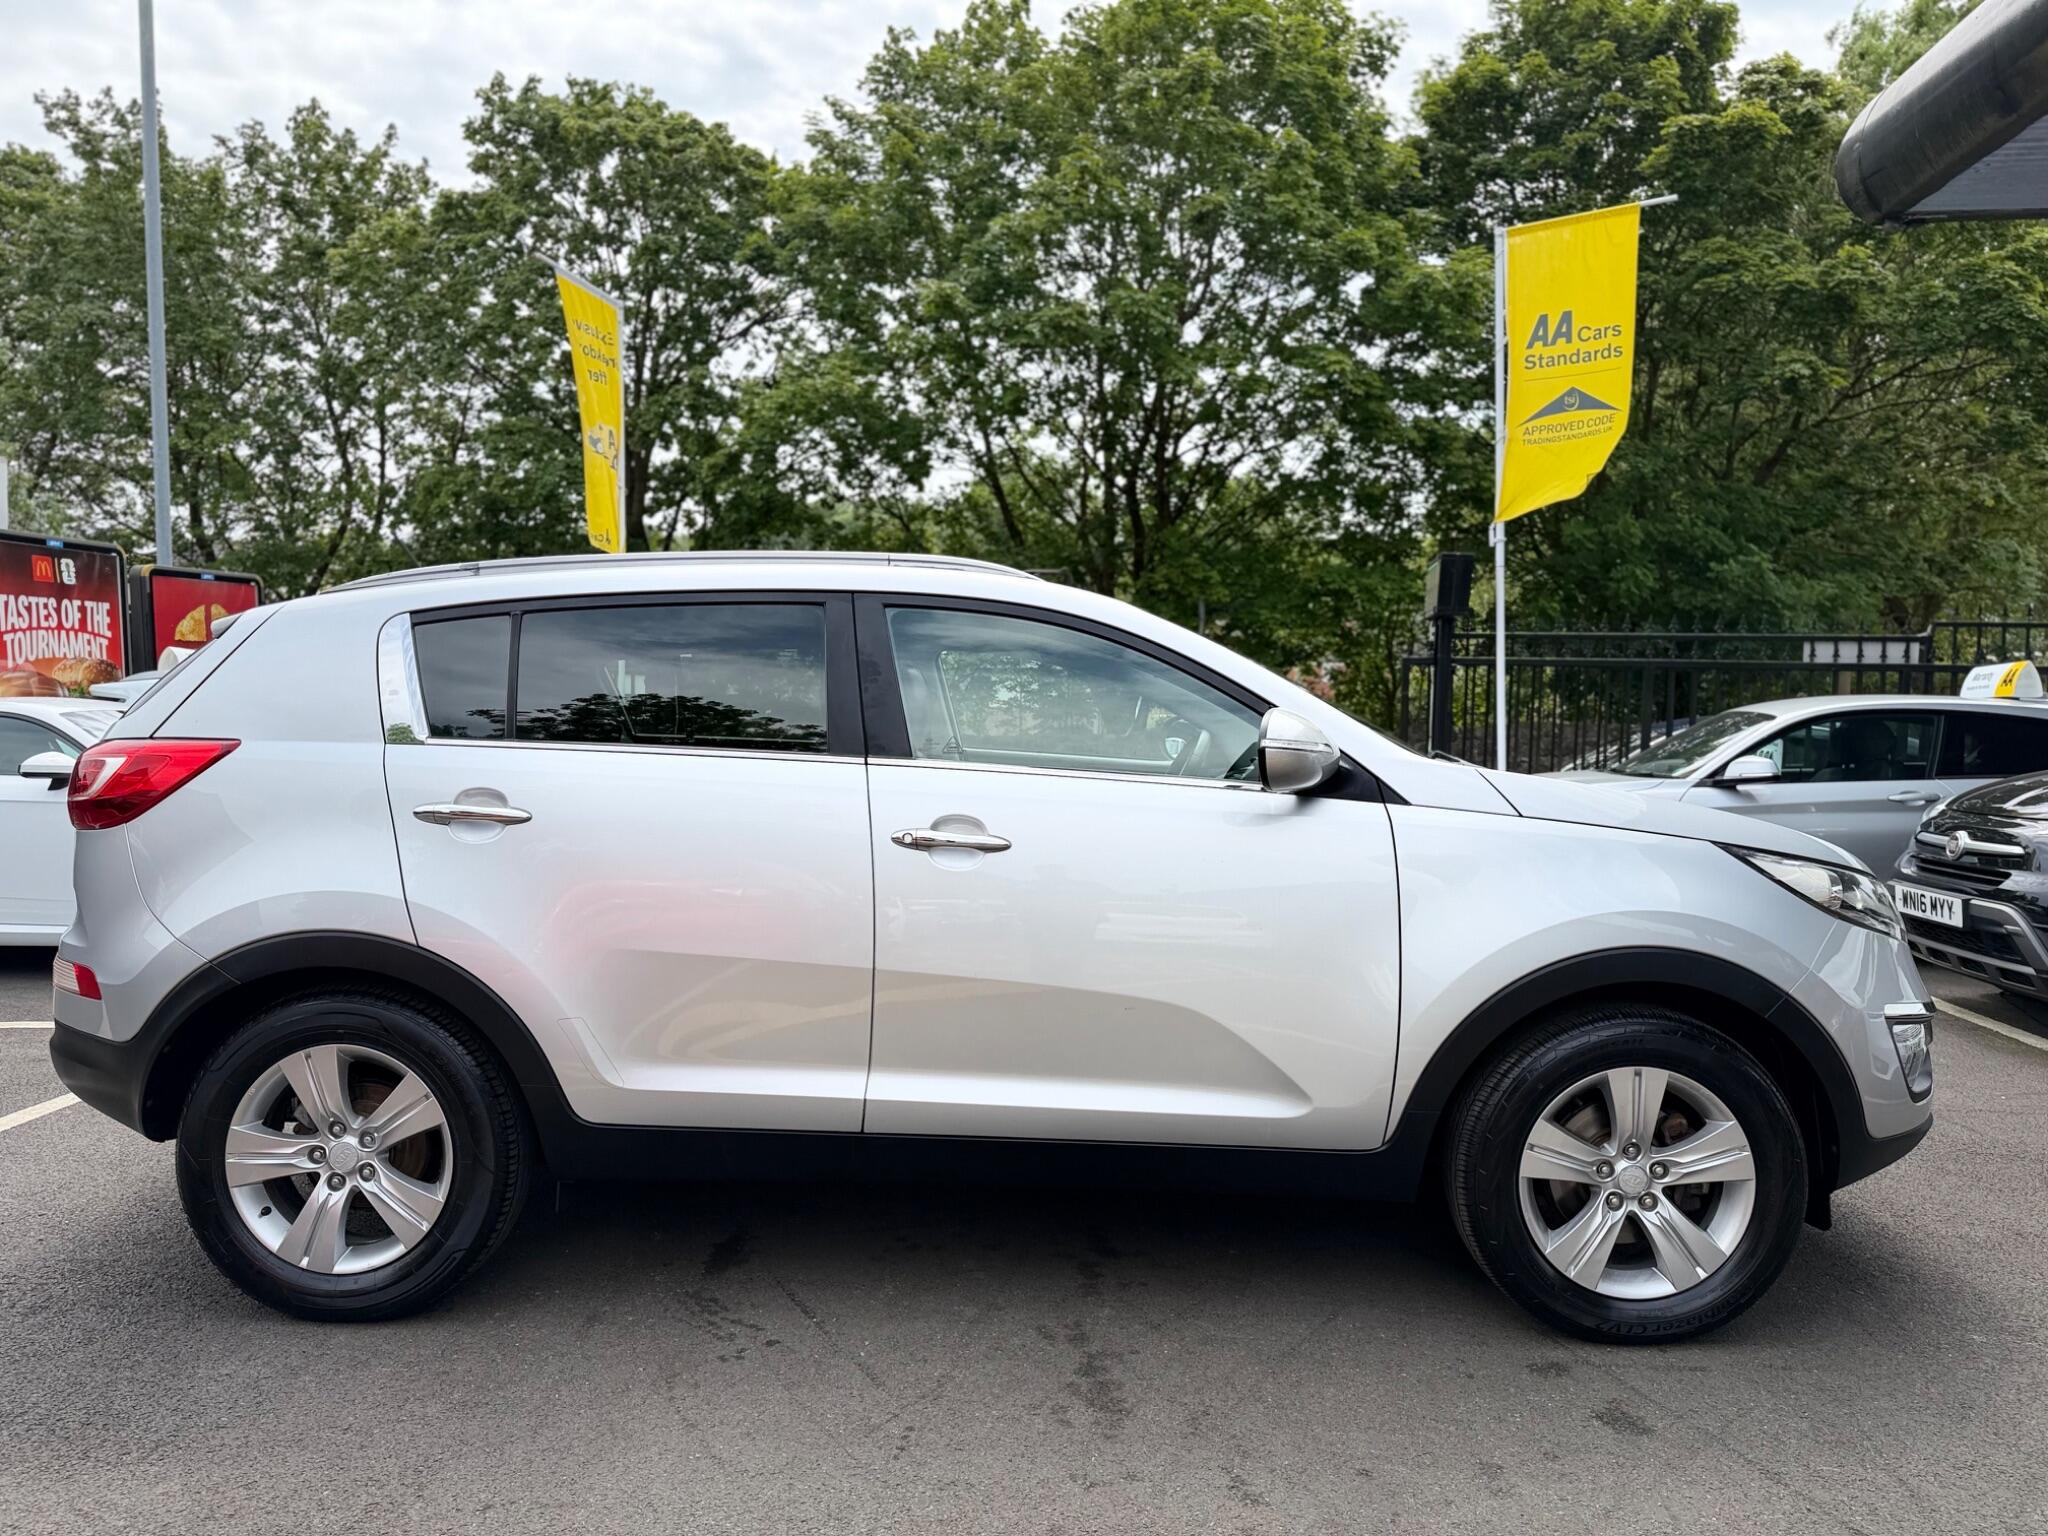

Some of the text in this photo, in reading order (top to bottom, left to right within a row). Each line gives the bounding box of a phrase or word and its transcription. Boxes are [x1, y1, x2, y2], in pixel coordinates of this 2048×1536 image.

[1526, 310, 1622, 349] AA Cars
[1524, 343, 1623, 370] Standards
[1523, 413, 1616, 437] APPROVED CODE
[61, 598, 81, 629] OF
[84, 600, 112, 638] THE
[3, 629, 108, 669] TOURNAMENT
[1902, 889, 1954, 920] WN16 MYY
